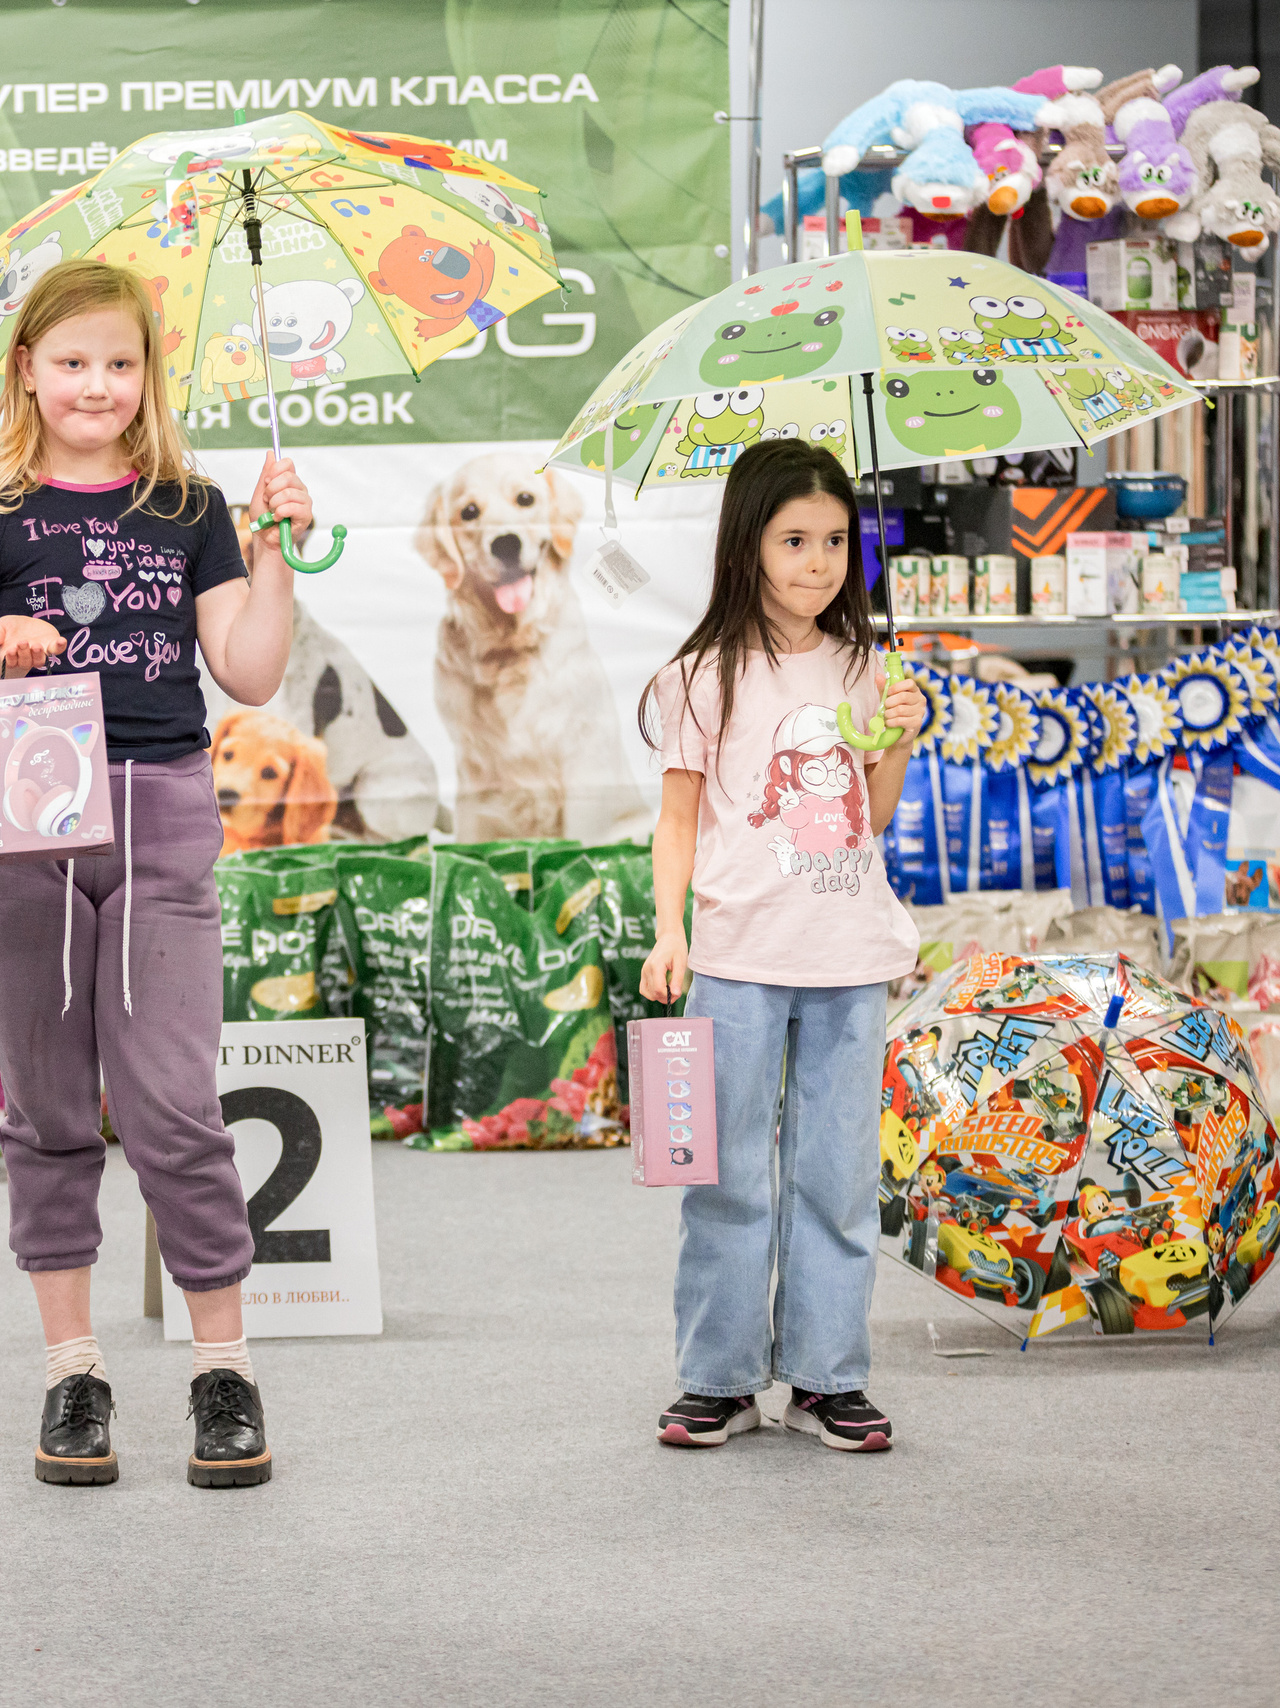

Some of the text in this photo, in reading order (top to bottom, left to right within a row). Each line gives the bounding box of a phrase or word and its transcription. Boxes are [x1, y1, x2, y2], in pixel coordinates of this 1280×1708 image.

[121, 77, 378, 112] ПРЕМИУМ
[390, 72, 600, 107] КЛАССА
[247, 382, 415, 428] собак
[22, 518, 41, 542] I
[28, 575, 65, 620] I
[67, 626, 181, 683] love you
[28, 698, 95, 719] беспроводные
[814, 812, 845, 825] LOVE
[810, 870, 861, 897] day
[662, 1031, 692, 1047] CAT
[992, 1015, 1056, 1078] LET'S
[959, 1111, 1045, 1139] SPEED
[936, 1133, 1070, 1175] ROADSTERS
[1104, 1127, 1192, 1192] ROLL
[218, 1086, 332, 1264] 2
[1157, 1248, 1190, 1261] 28
[273, 1290, 282, 1304] В
